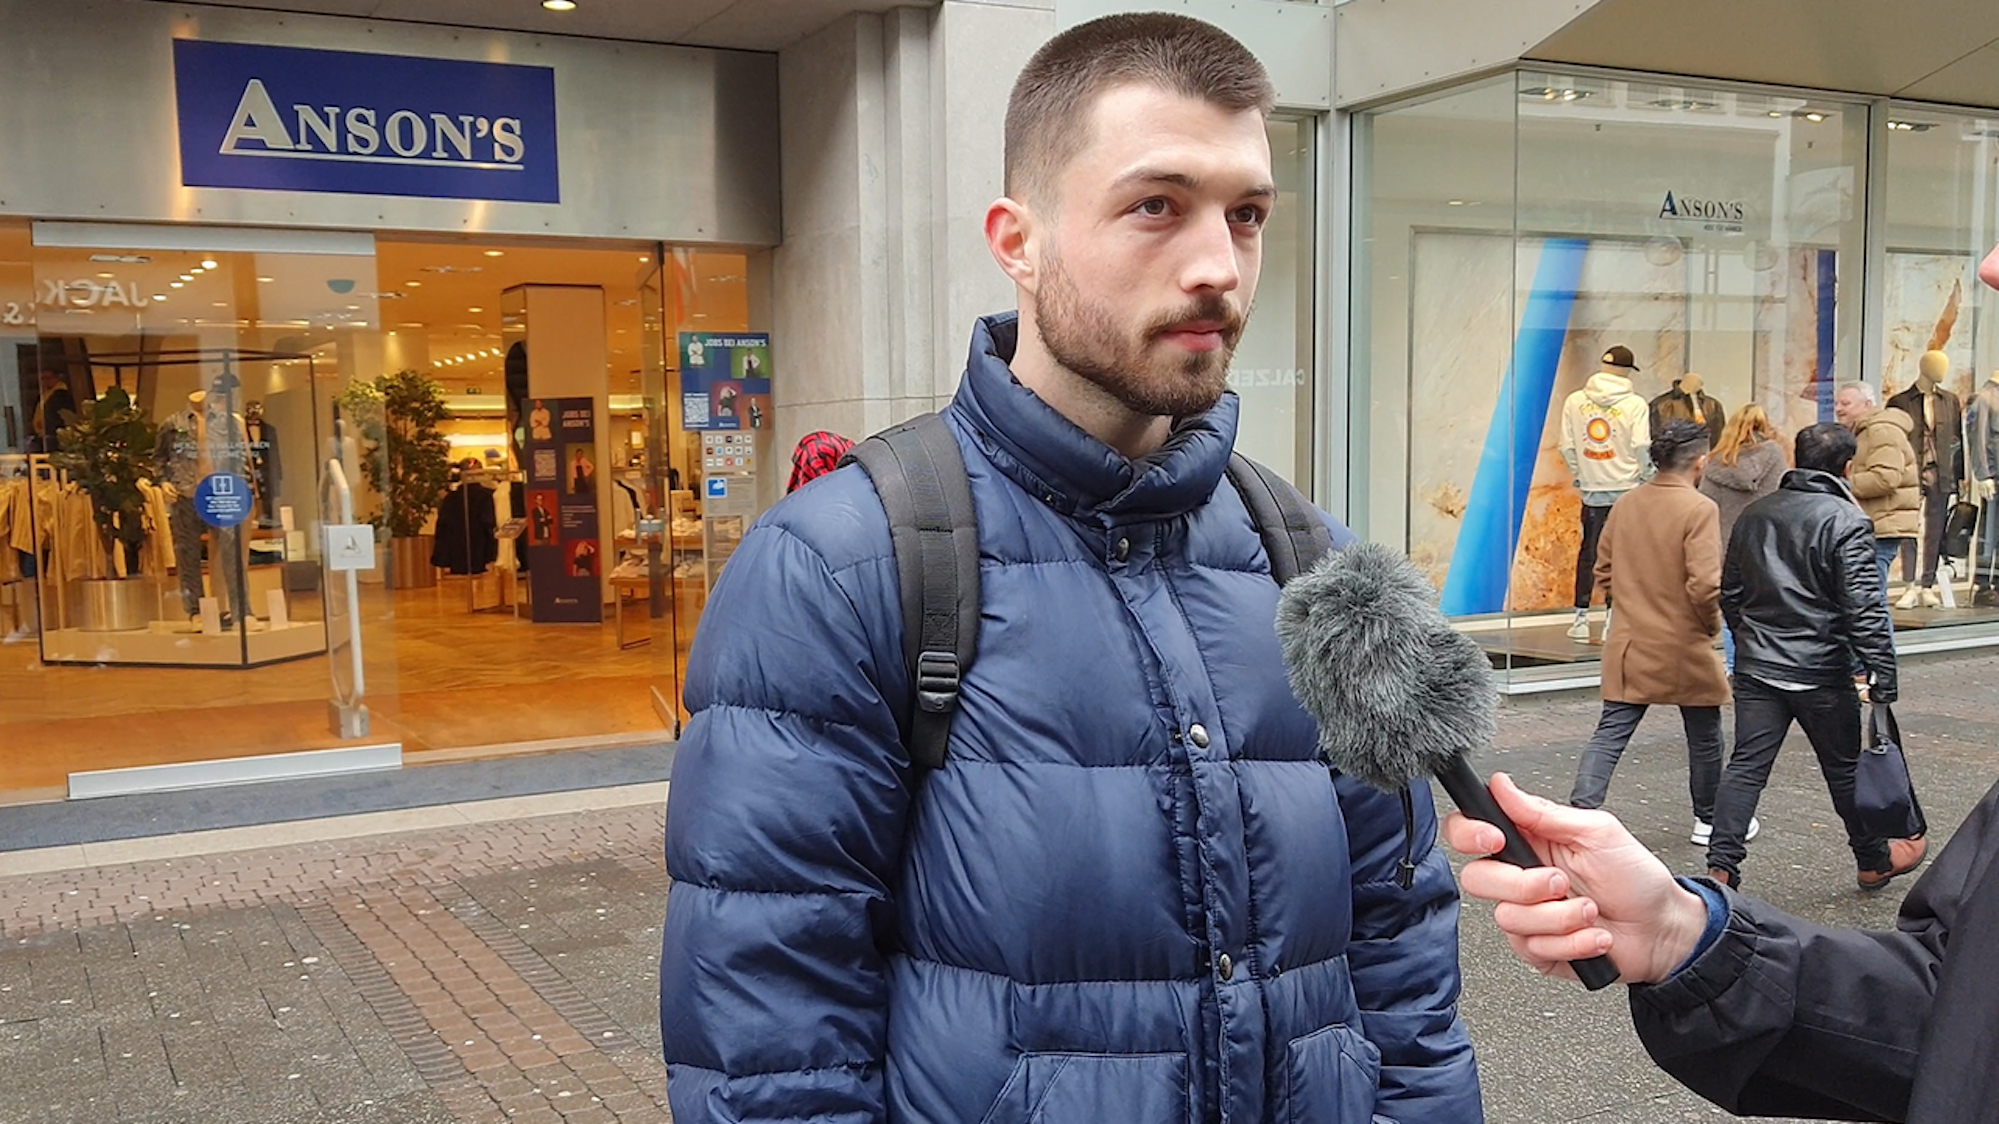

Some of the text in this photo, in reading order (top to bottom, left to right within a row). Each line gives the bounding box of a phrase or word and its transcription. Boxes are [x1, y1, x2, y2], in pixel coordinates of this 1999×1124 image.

[218, 78, 525, 163] ANSON'S
[1659, 189, 1743, 220] ANSON'S
[704, 338, 767, 348] JOBS BEI ANSON'S
